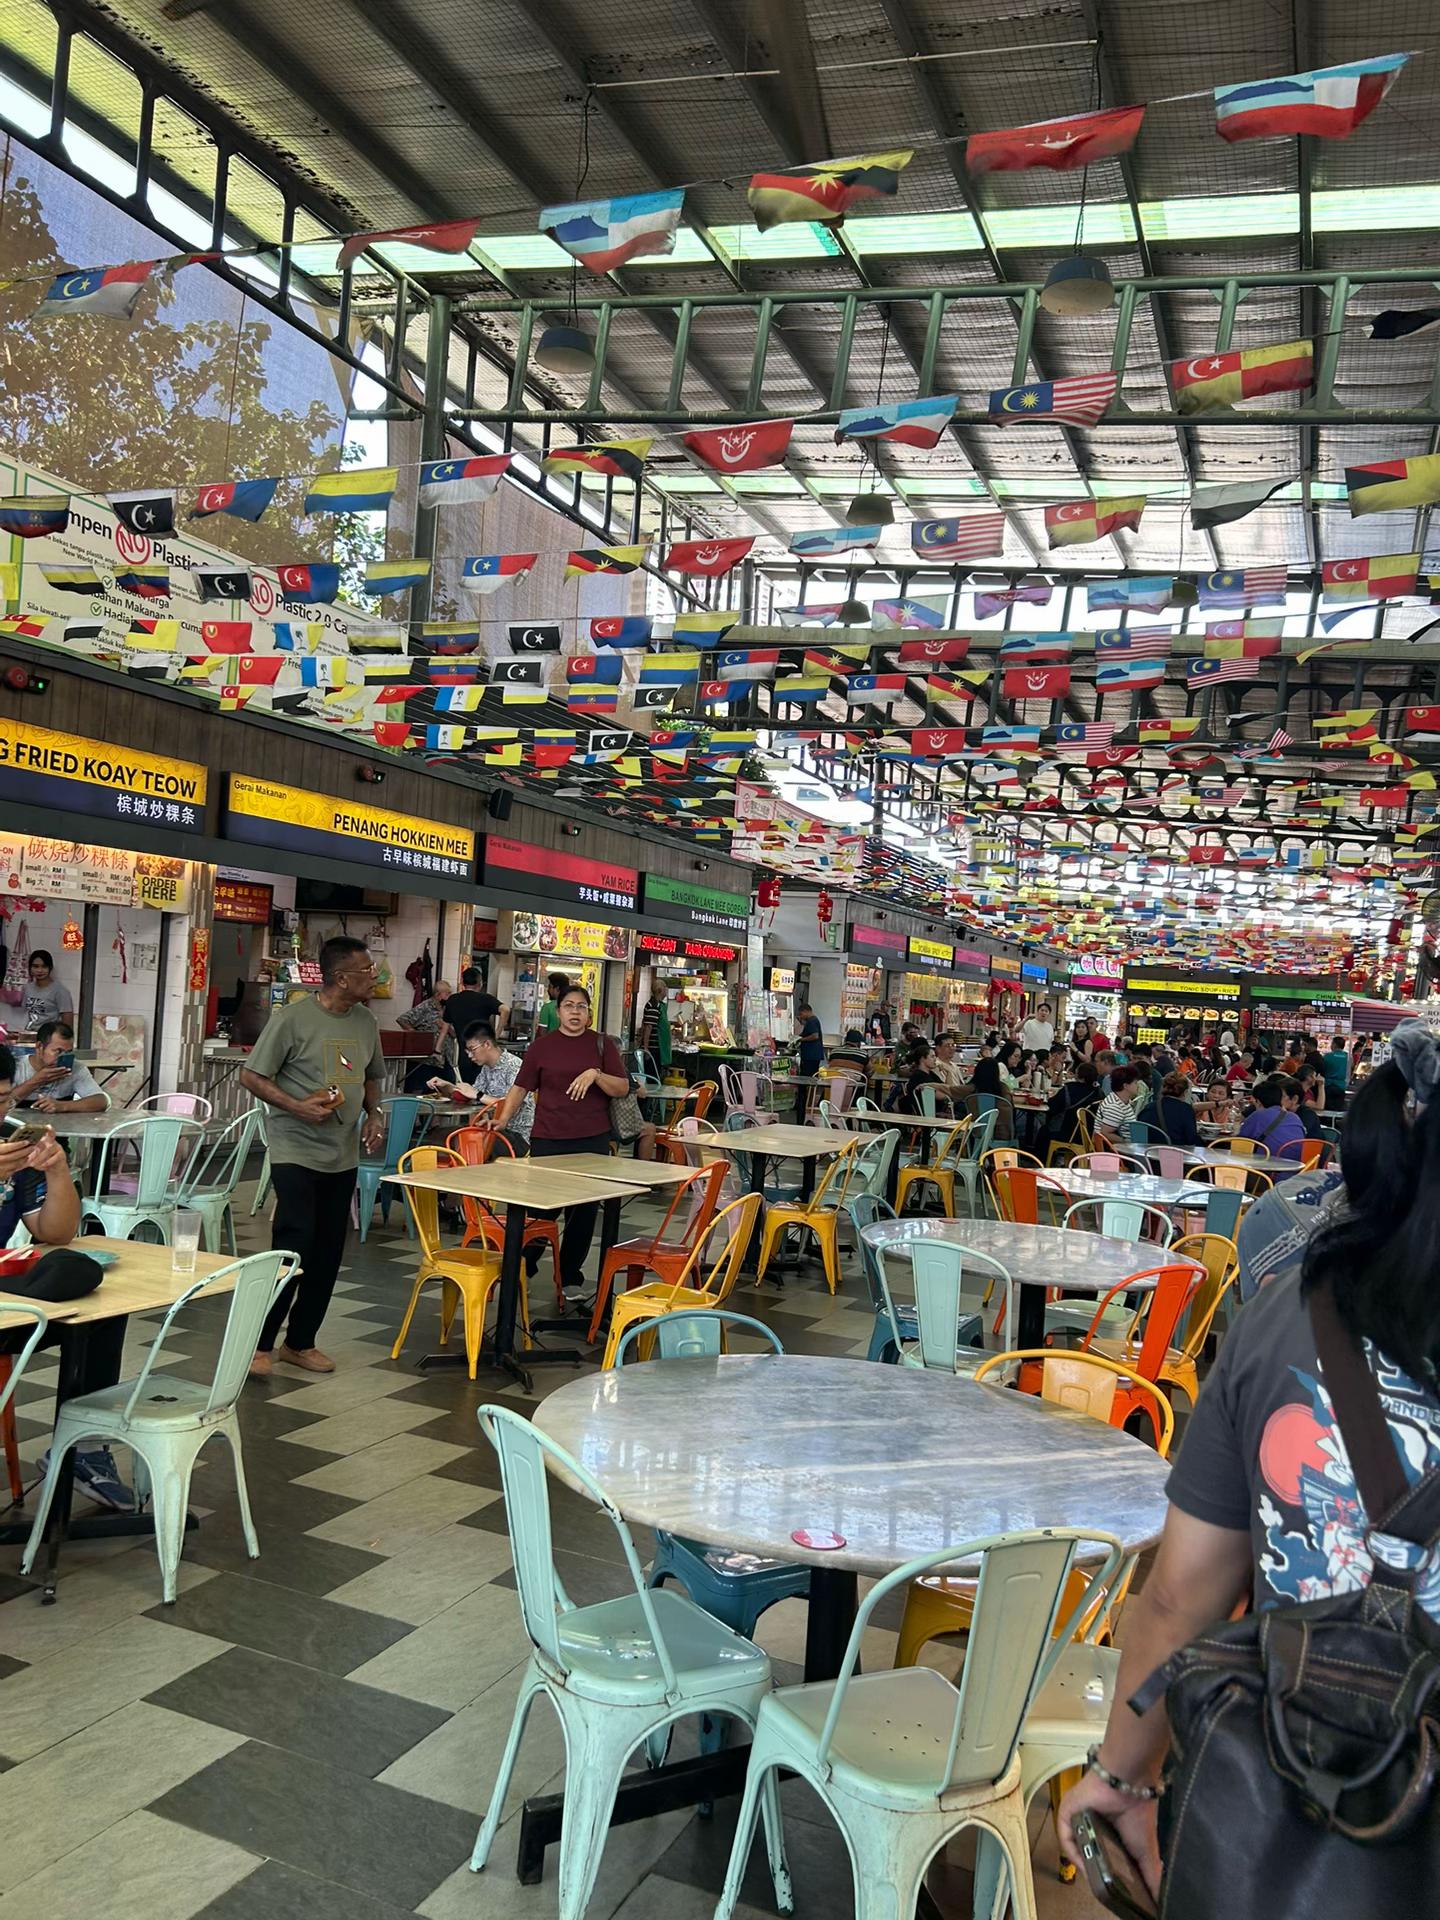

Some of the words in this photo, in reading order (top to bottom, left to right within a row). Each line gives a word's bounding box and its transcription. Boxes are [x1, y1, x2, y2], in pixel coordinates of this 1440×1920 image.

[68, 510, 112, 540] mpen
[119, 530, 147, 555] NO
[15, 742, 79, 774] FRIED
[83, 757, 138, 787] KOAY
[142, 770, 197, 799] TEOW
[234, 780, 254, 793] Gerai
[255, 784, 287, 800] Makanan
[117, 793, 195, 825] 槟城炒粿条
[333, 813, 389, 839] PENANG
[390, 826, 444, 851] HOKKIEN
[446, 839, 468, 856] MEE
[142, 876, 177, 890] ORDER
[601, 873, 617, 887] YAM
[618, 878, 636, 893] RICE
[141, 888, 177, 902] HERE
[671, 889, 700, 906] BANGKOK
[700, 896, 715, 909] LANE
[691, 910, 715, 924] Bangkok
[715, 915, 728, 926] Lane
